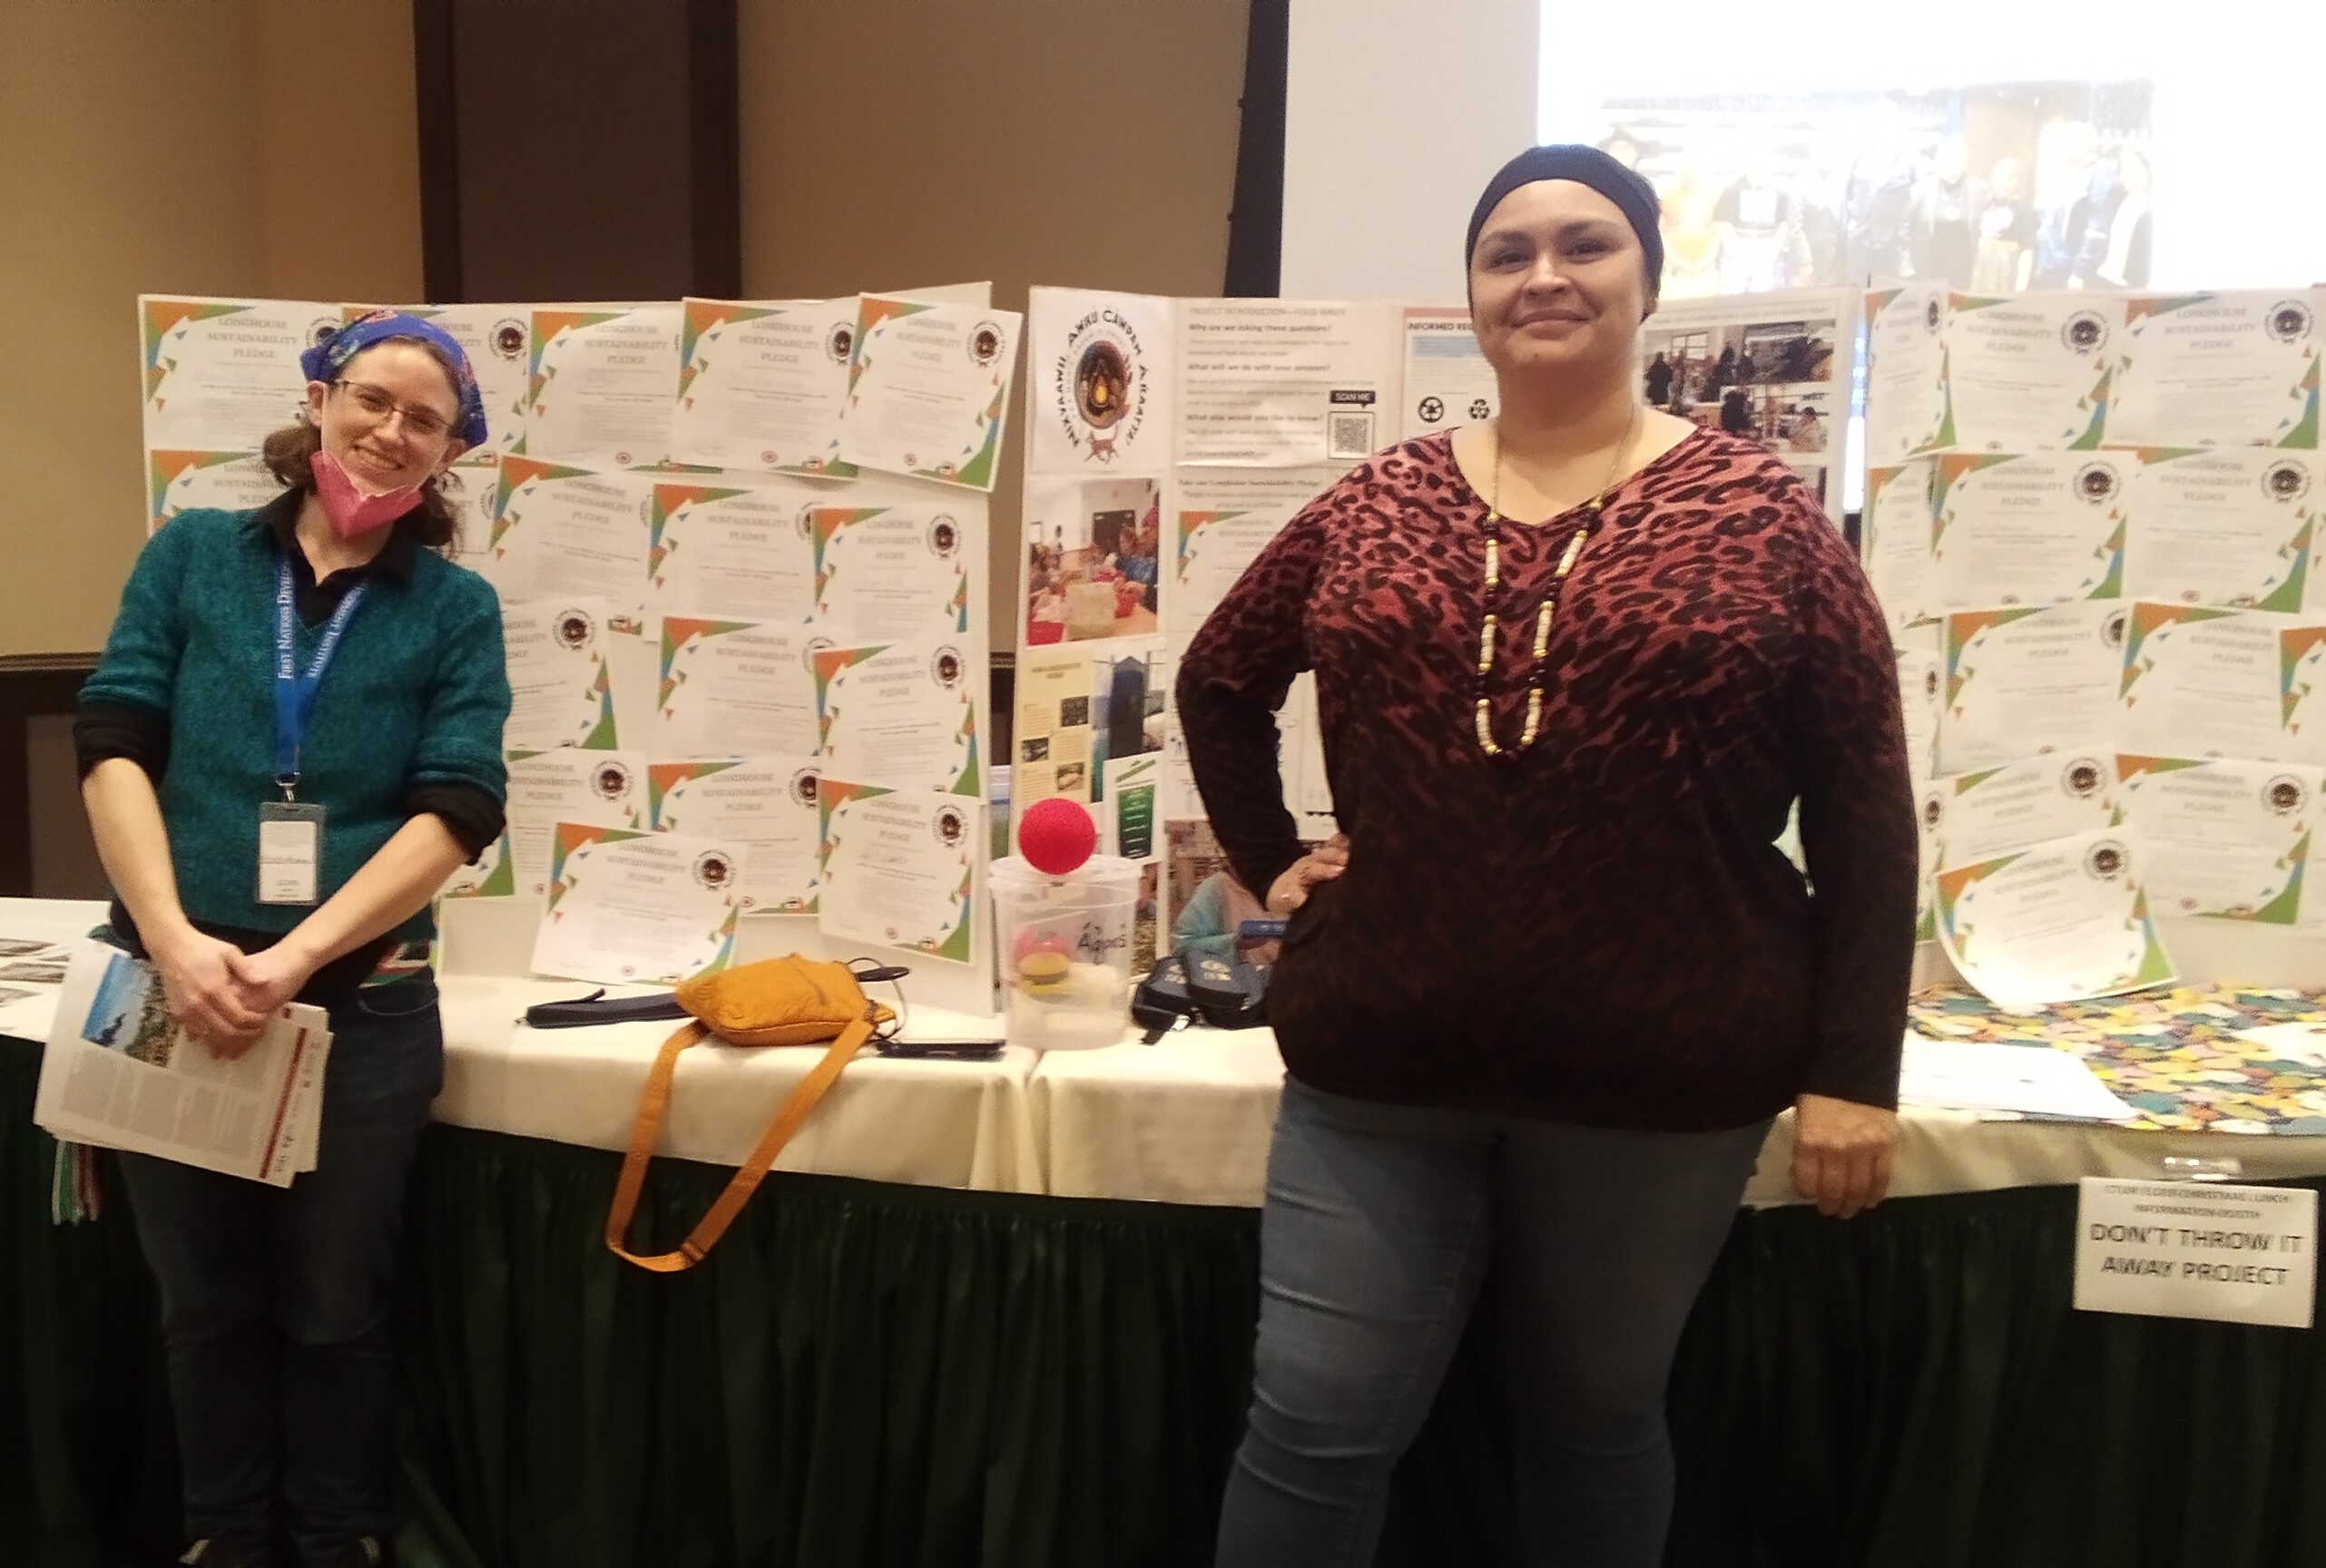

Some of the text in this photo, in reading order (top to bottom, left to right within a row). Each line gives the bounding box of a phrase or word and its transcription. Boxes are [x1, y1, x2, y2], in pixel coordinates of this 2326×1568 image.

[1189, 324, 1207, 332] Why
[1238, 324, 1262, 332] asking
[1289, 324, 1331, 332] questions?
[1408, 322, 1454, 330] INFORMED
[232, 348, 276, 358] PLEDGE
[607, 355, 646, 365] PLEDGE
[761, 353, 800, 364] PLEDGE
[1335, 393, 1355, 401] SCAN
[729, 531, 767, 543] PLEDGE
[2089, 1223, 2304, 1252] DON'T THROW IT
[2100, 1257, 2291, 1286] AWAY PROJECT
